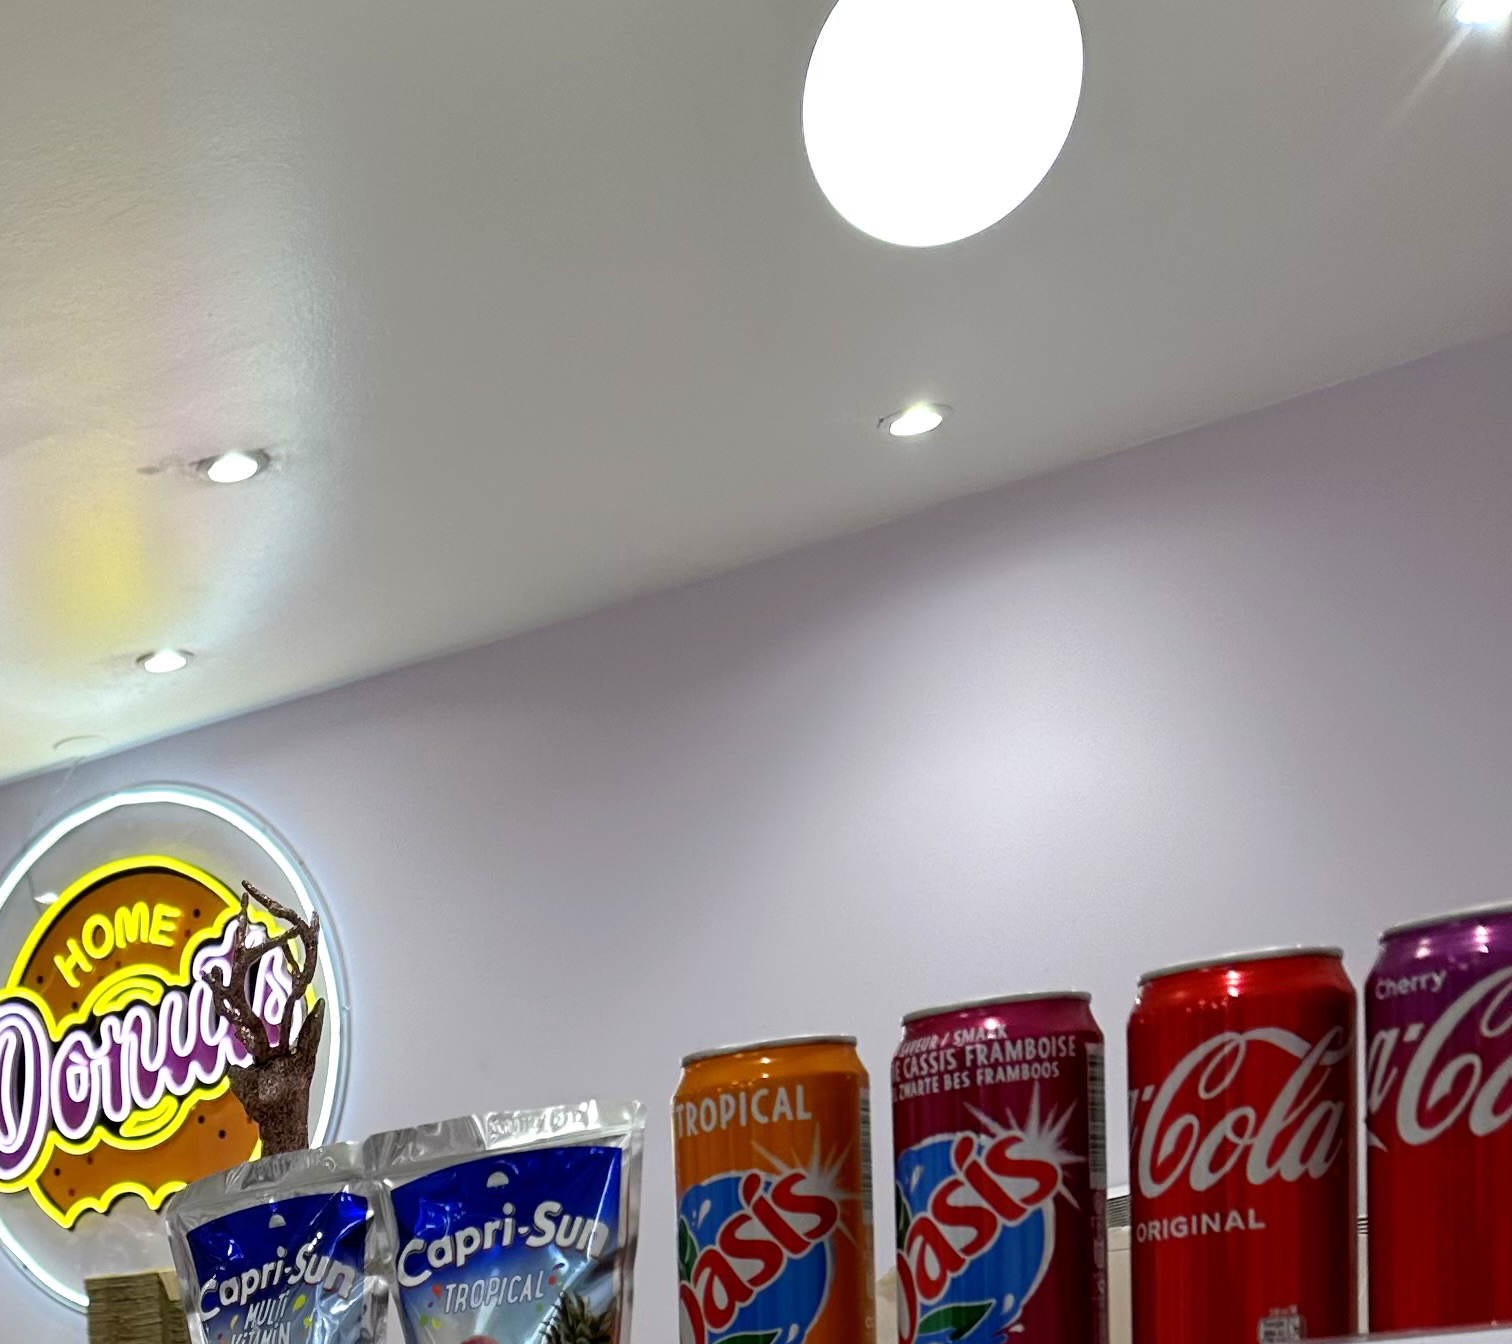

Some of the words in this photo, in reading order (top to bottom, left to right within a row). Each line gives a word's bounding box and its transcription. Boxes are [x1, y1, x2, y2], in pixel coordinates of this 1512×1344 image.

[52, 900, 183, 989] HOME
[903, 1049, 958, 1078] CASSIS
[965, 1035, 1076, 1068] FRAMBOISE
[944, 1071, 970, 1092] BES
[976, 1061, 1061, 1087] FRAMBOOS
[676, 1084, 812, 1138] TROPICAL
[396, 1201, 611, 1287] Capri-Sun
[1137, 1209, 1266, 1243] ORIGINAL
[199, 1243, 356, 1321] Capri-Sun
[443, 1270, 544, 1314] TROPICAL
